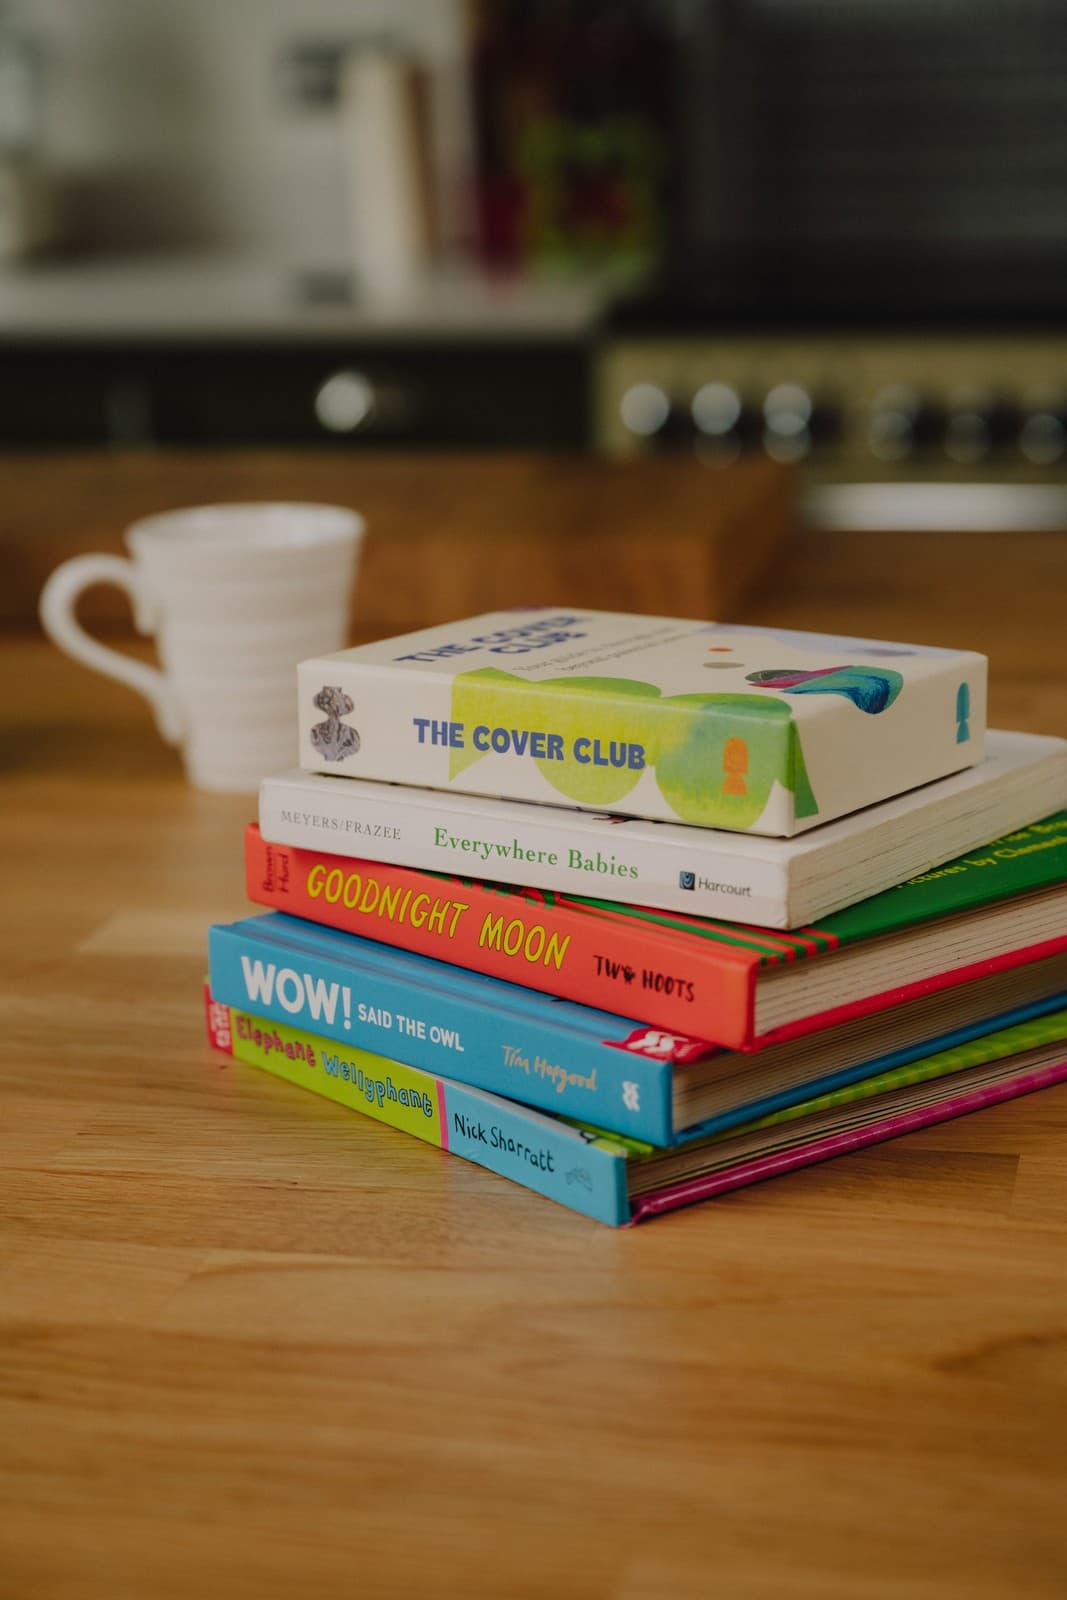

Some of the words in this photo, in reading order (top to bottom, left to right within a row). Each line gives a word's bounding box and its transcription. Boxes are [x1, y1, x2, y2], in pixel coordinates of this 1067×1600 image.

[393, 643, 481, 662] THE
[488, 632, 587, 654] CLUB
[413, 717, 465, 748] THE
[472, 725, 565, 761] COVER
[573, 737, 646, 771] CLUB
[280, 809, 402, 841] MEYERS/FRAZEE
[434, 827, 558, 866] Everywhere
[568, 849, 639, 879] Babies
[698, 877, 752, 898] Harcourt
[307, 863, 470, 938] GOODNIGHT
[478, 911, 572, 970] MOON
[240, 955, 352, 1031] WOW!
[357, 1003, 393, 1029] SAID
[396, 1014, 426, 1040] THE
[430, 1026, 465, 1052] OWL
[642, 970, 696, 1003] HOOTS
[235, 1015, 317, 1068] Elephant
[321, 1051, 434, 1118] Wellyphant
[501, 1044, 531, 1075] Tim
[454, 1112, 488, 1145] Nick
[490, 1126, 555, 1173] Sharratt
